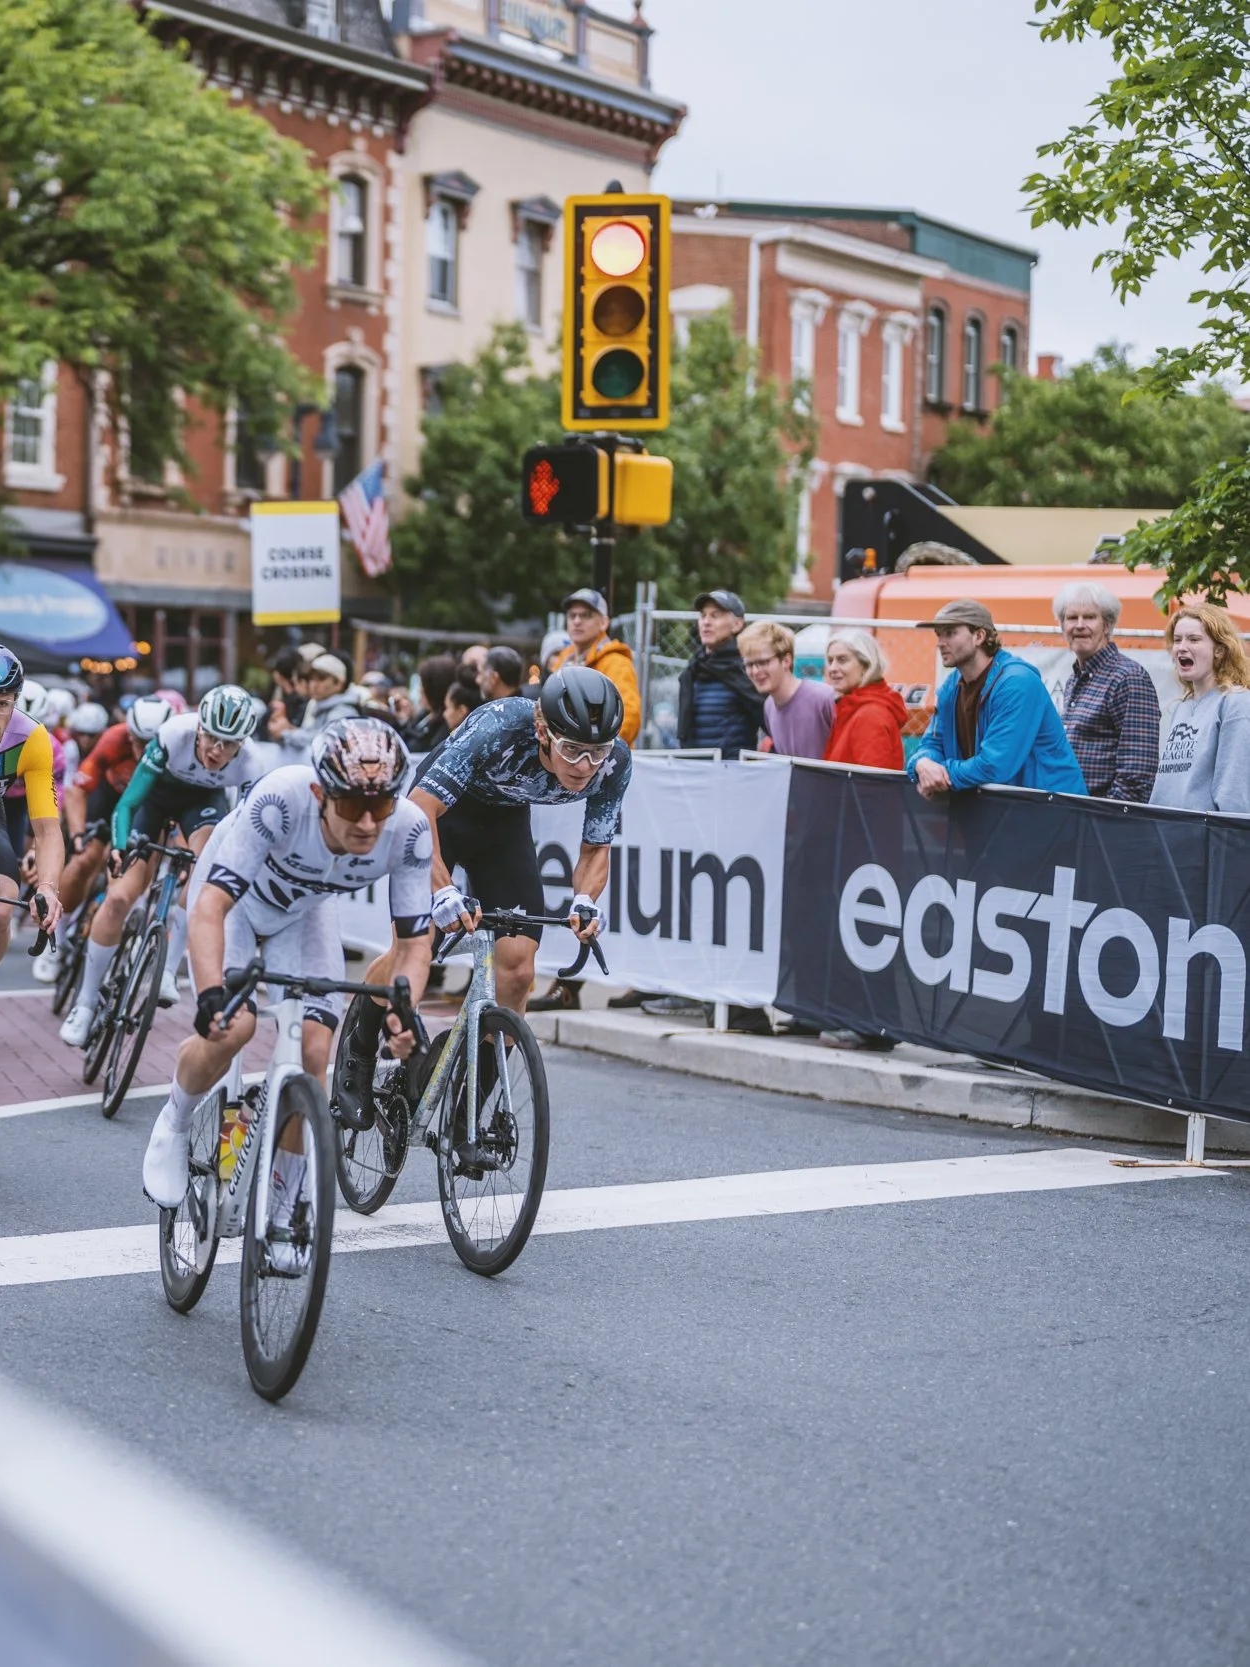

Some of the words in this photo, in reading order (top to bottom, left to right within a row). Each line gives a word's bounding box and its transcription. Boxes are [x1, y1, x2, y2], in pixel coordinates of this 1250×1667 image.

[268, 547, 323, 560] COURSE
[261, 565, 332, 581] CROSSING
[1162, 750, 1195, 761] EAGUE
[421, 775, 457, 806] SRAM
[839, 863, 1247, 1051] easton
